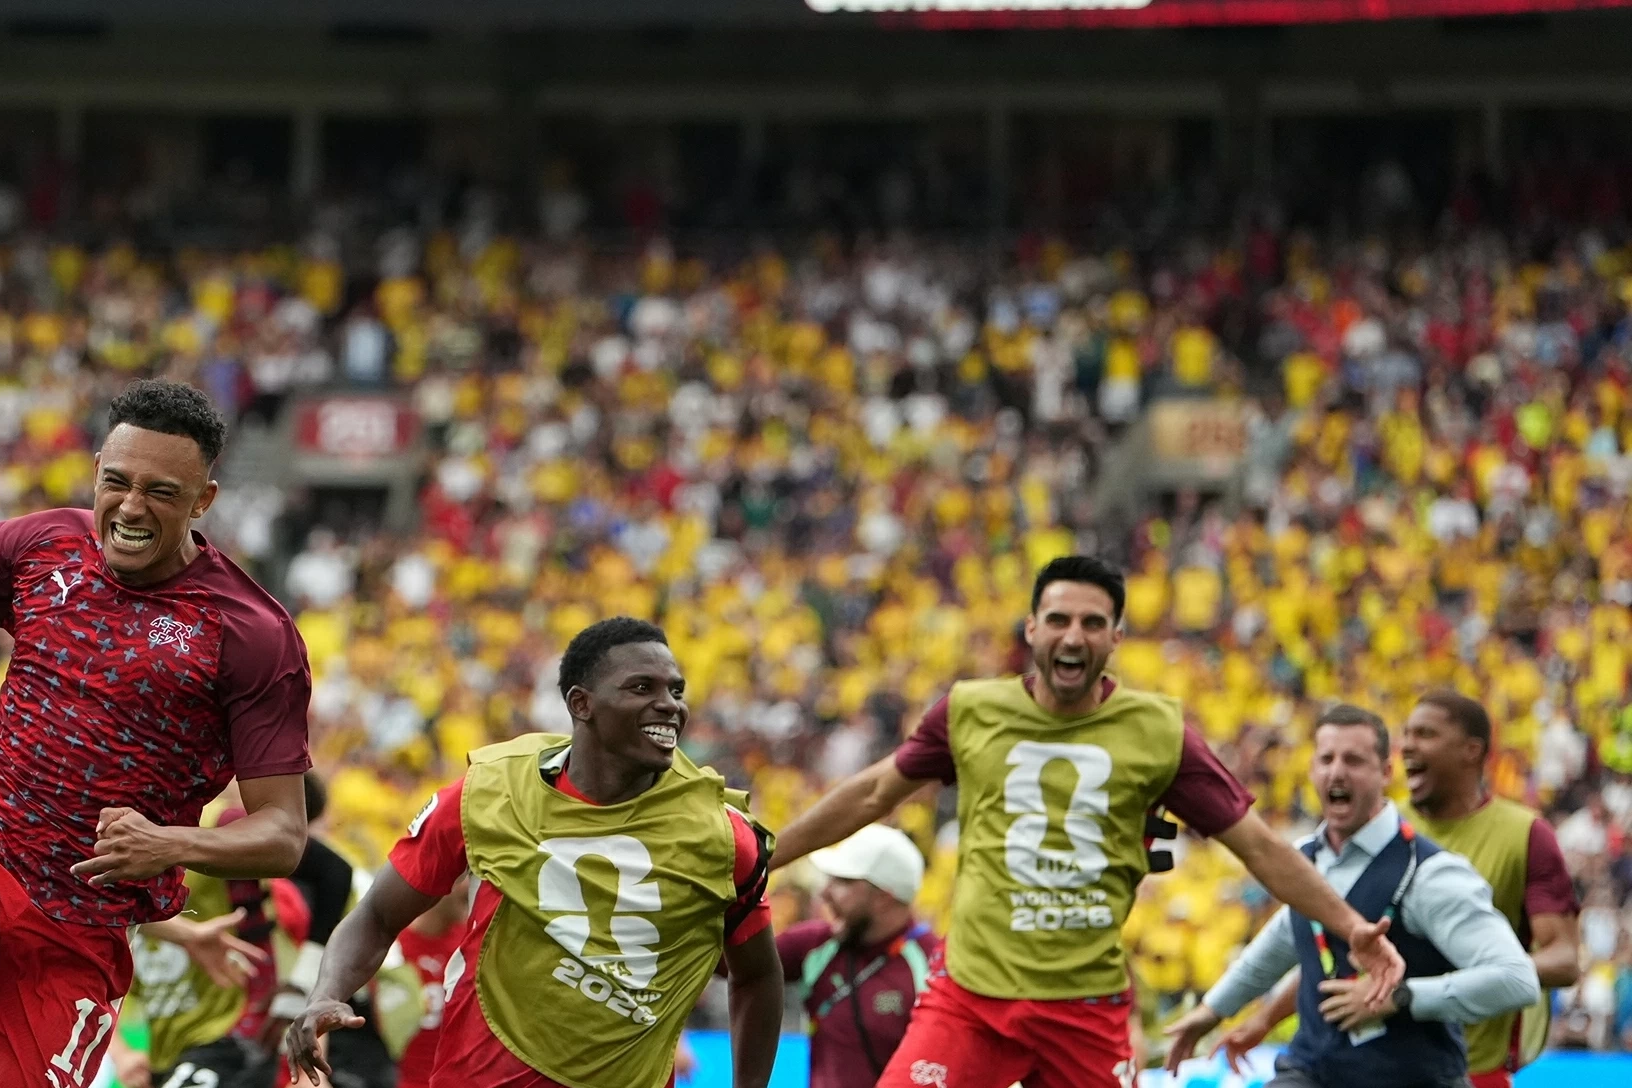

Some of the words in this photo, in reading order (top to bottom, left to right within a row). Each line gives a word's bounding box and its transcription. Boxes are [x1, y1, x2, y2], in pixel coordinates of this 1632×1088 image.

[1035, 858, 1082, 873] FIFA
[1009, 906, 1114, 931] 2026
[551, 957, 658, 1026] 2026
[50, 997, 113, 1088] 11
